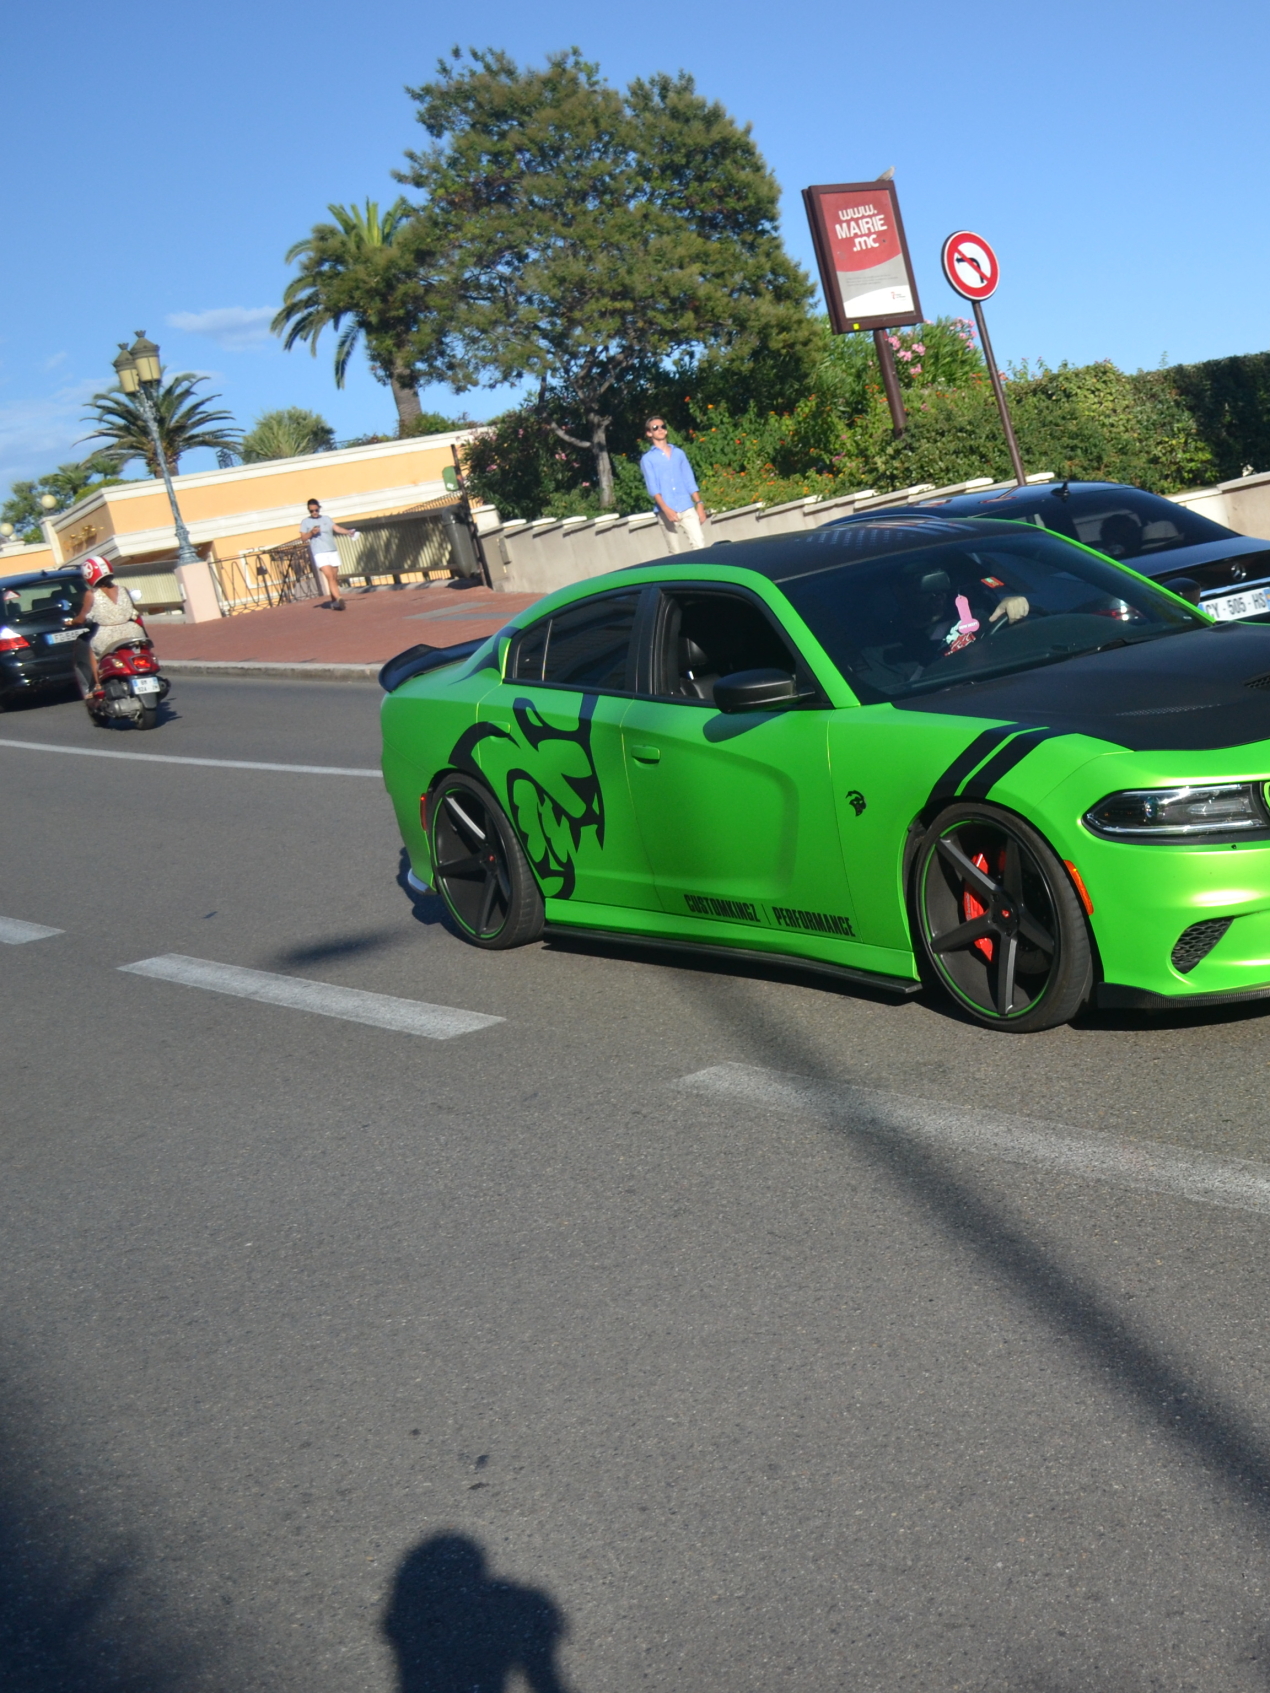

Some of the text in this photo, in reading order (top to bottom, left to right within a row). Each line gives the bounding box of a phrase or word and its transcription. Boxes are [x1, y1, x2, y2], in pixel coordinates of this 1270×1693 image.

[838, 204, 877, 220] www.
[835, 214, 888, 239] MAIRIE
[853, 234, 879, 252] .mc
[683, 893, 856, 937] CUSTOMKINGZ PERFORMANCE
